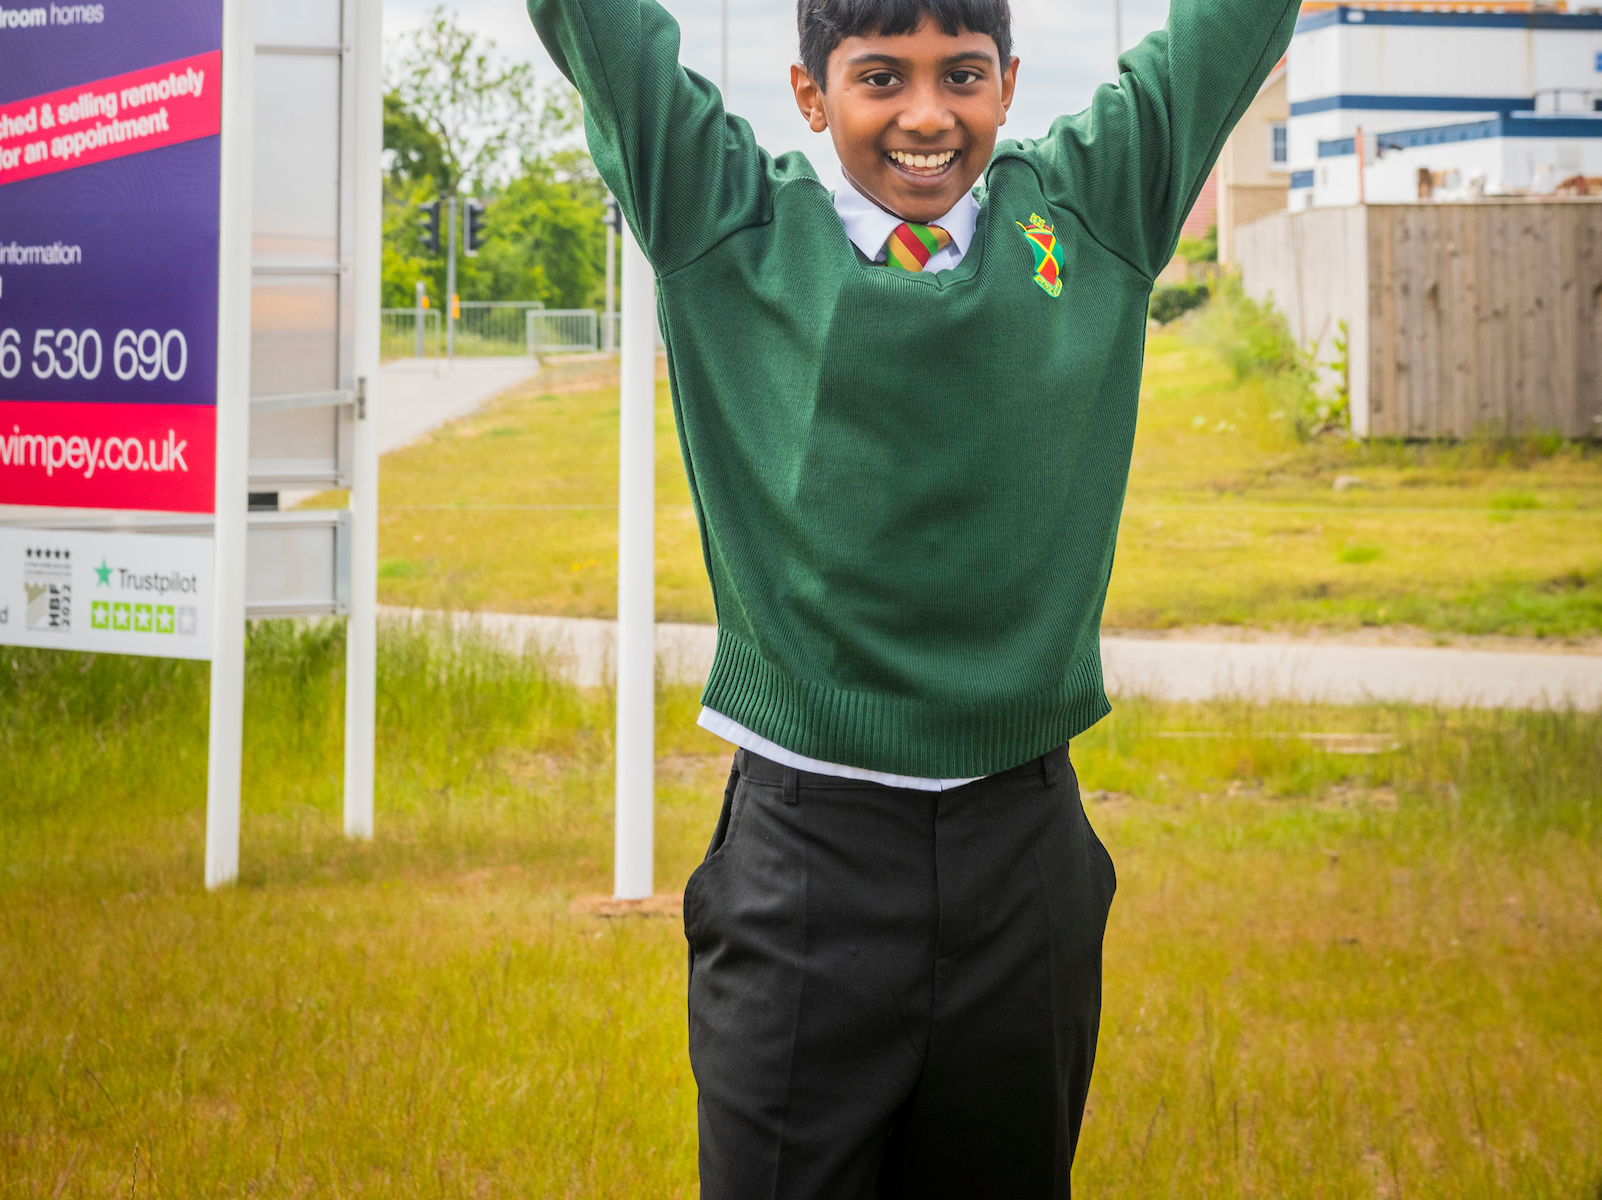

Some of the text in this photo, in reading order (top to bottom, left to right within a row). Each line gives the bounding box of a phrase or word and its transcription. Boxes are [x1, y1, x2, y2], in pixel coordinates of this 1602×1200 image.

[0, 1, 105, 29] room homes
[39, 102, 56, 130] &
[57, 92, 118, 125] selling
[120, 66, 205, 110] remotely
[24, 140, 49, 165] an
[51, 106, 170, 161] appointment
[32, 327, 103, 381] 530
[113, 328, 188, 382] 690
[118, 567, 198, 596] Trustpilot
